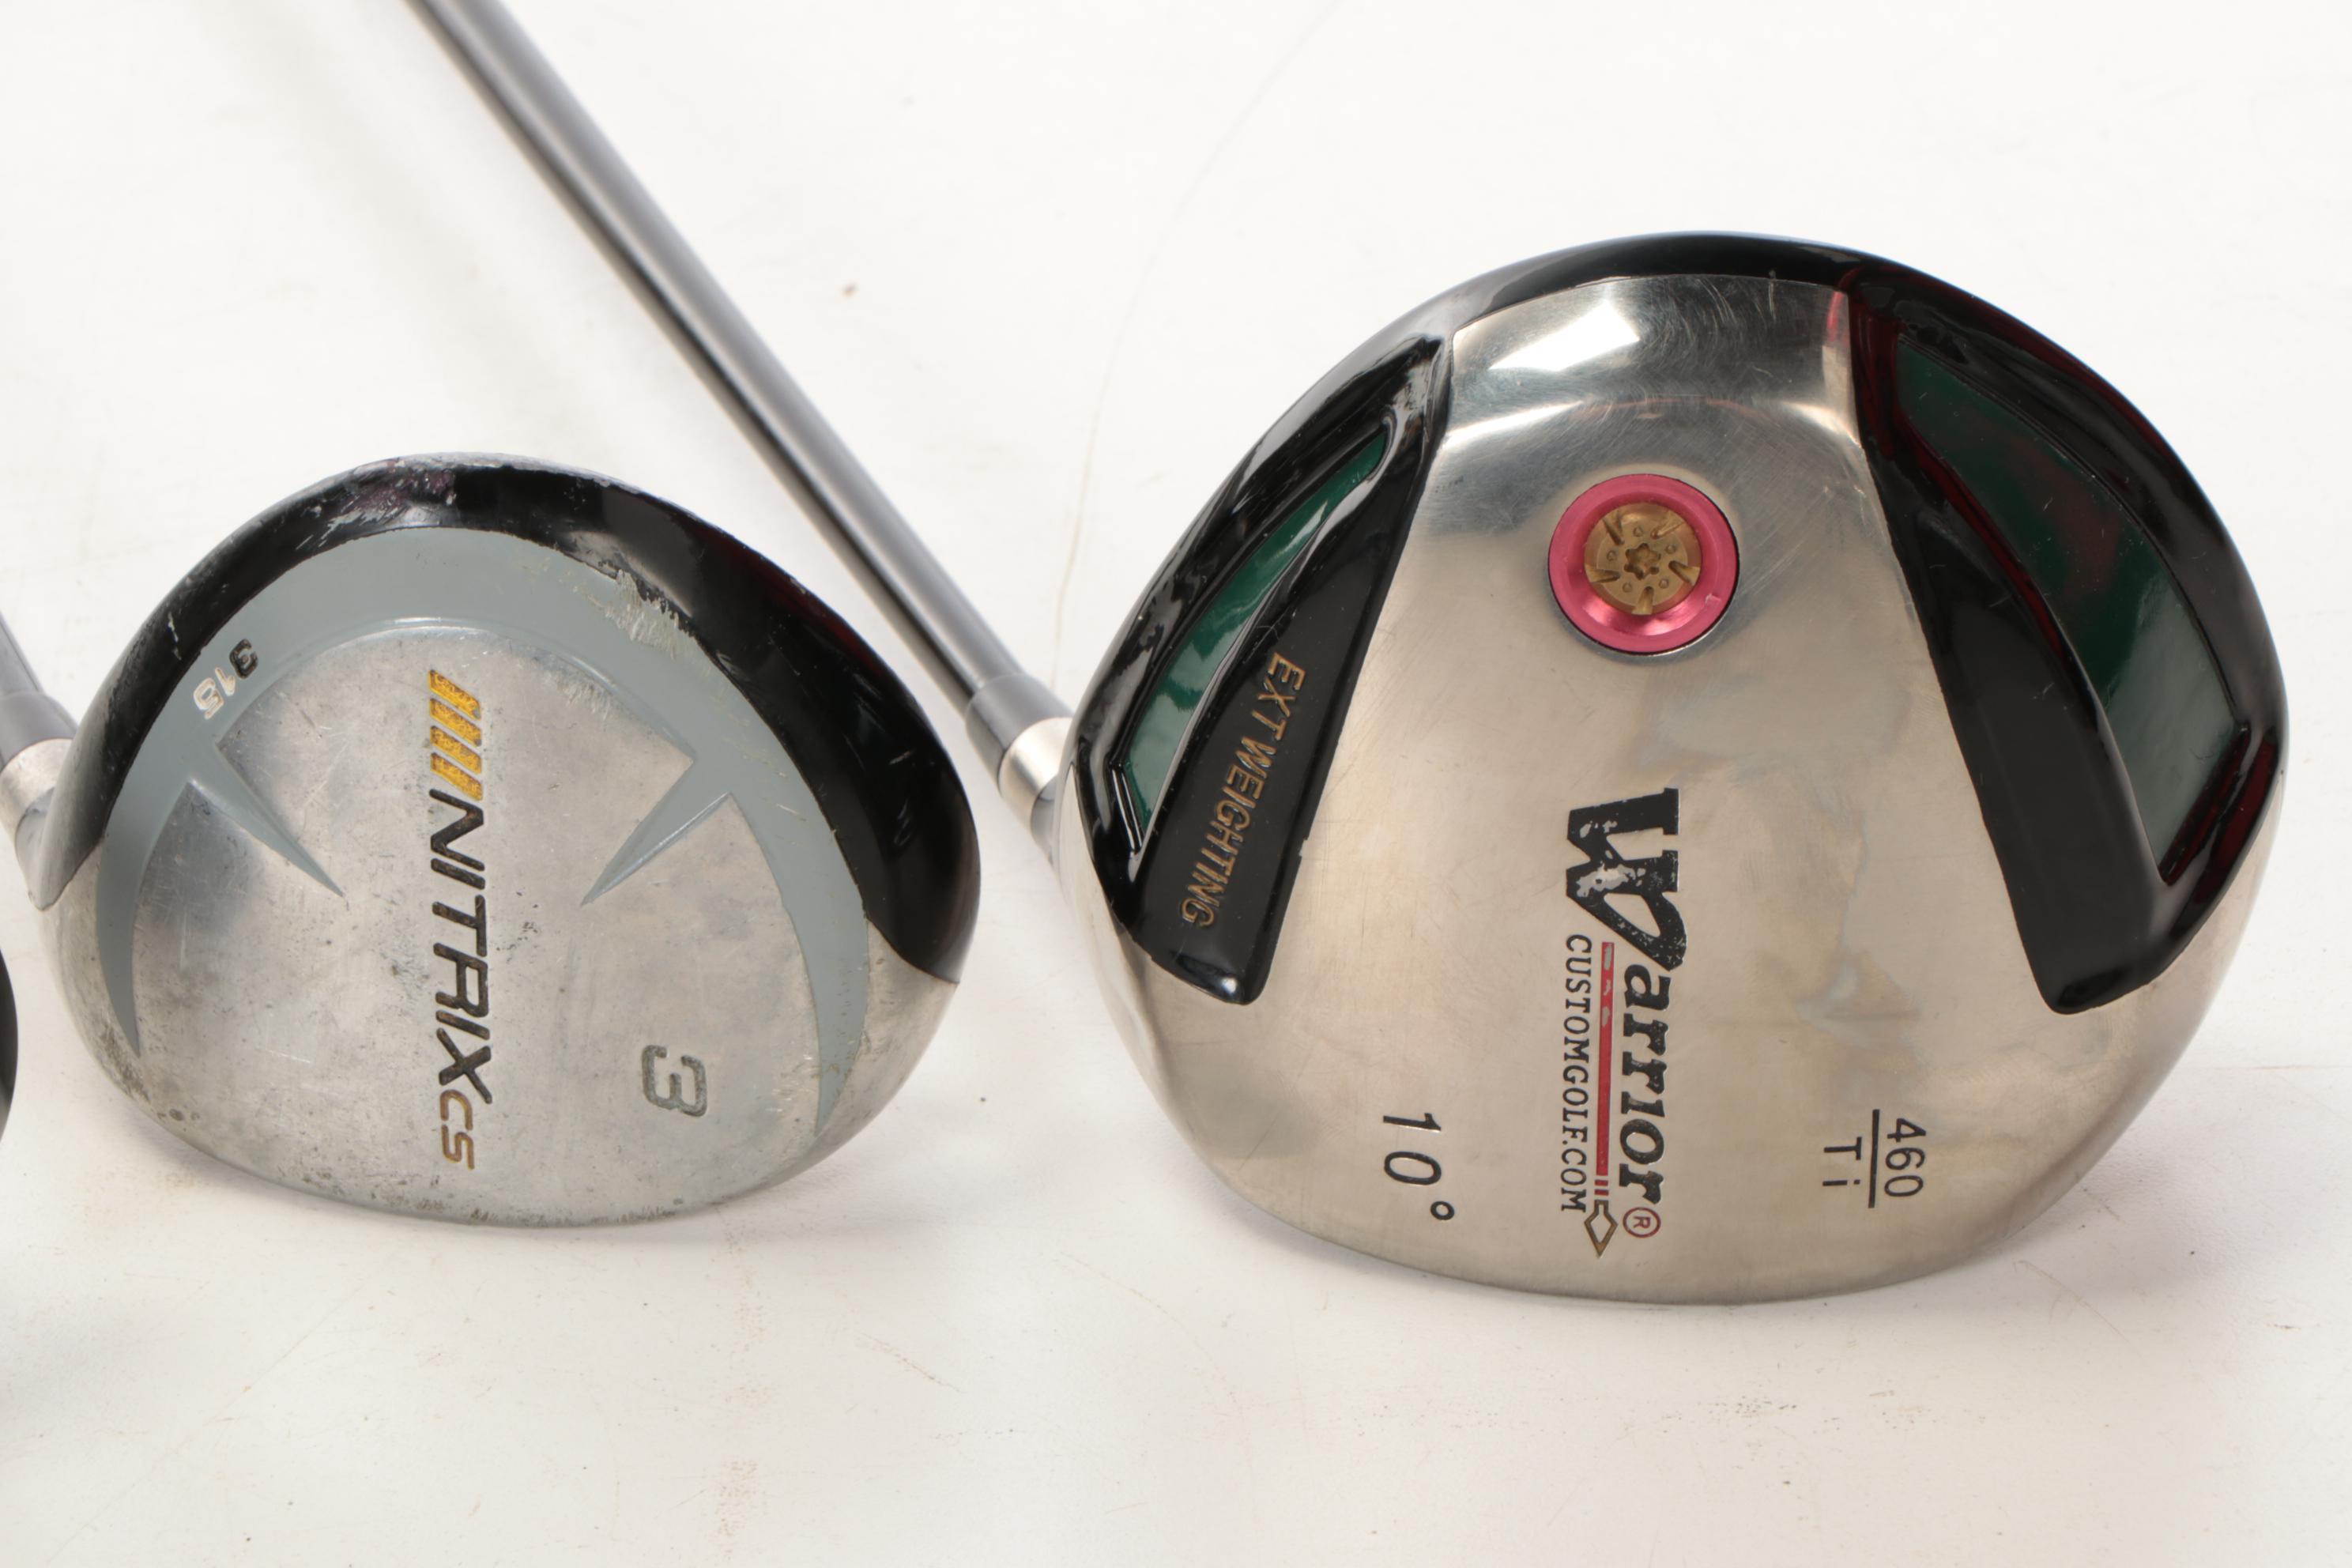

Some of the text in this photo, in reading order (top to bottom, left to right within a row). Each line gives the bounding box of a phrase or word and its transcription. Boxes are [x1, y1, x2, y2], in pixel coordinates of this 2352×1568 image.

[193, 638, 258, 720] 315
[1181, 652, 1306, 927] EXT WEIGHTING
[642, 1044, 707, 1118] 3
[1560, 933, 1593, 1213] CUSTOMGOLF.COM
[1883, 1117, 1927, 1197] 460
